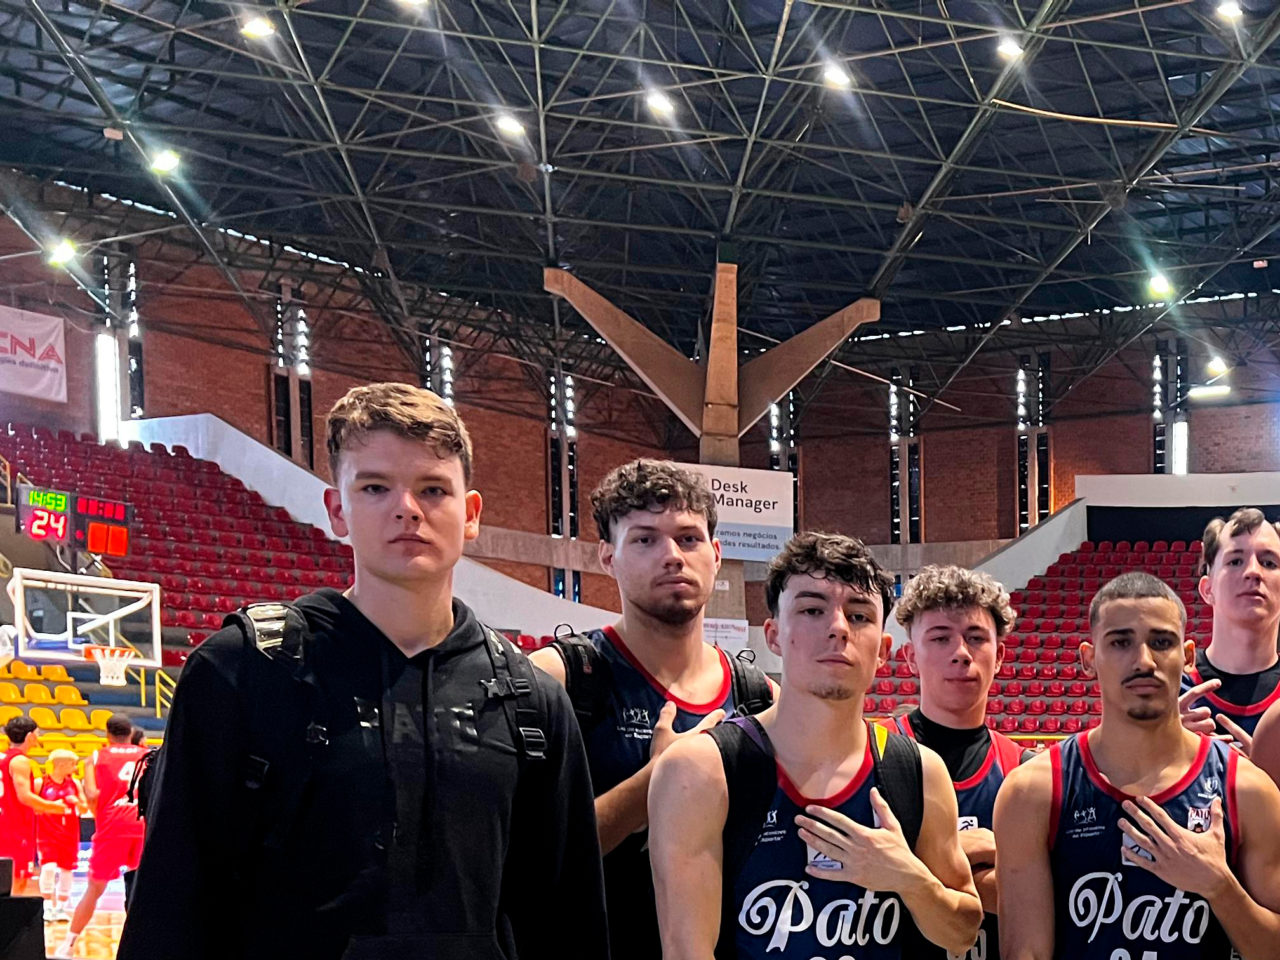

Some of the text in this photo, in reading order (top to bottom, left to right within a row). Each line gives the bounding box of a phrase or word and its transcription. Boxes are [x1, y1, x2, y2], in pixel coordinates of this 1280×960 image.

[711, 478, 748, 494] Desk
[29, 491, 67, 512] 14:53
[713, 493, 779, 513] Manager
[31, 510, 65, 538] 24
[738, 879, 901, 953] Pato
[1068, 871, 1210, 944] Pato
